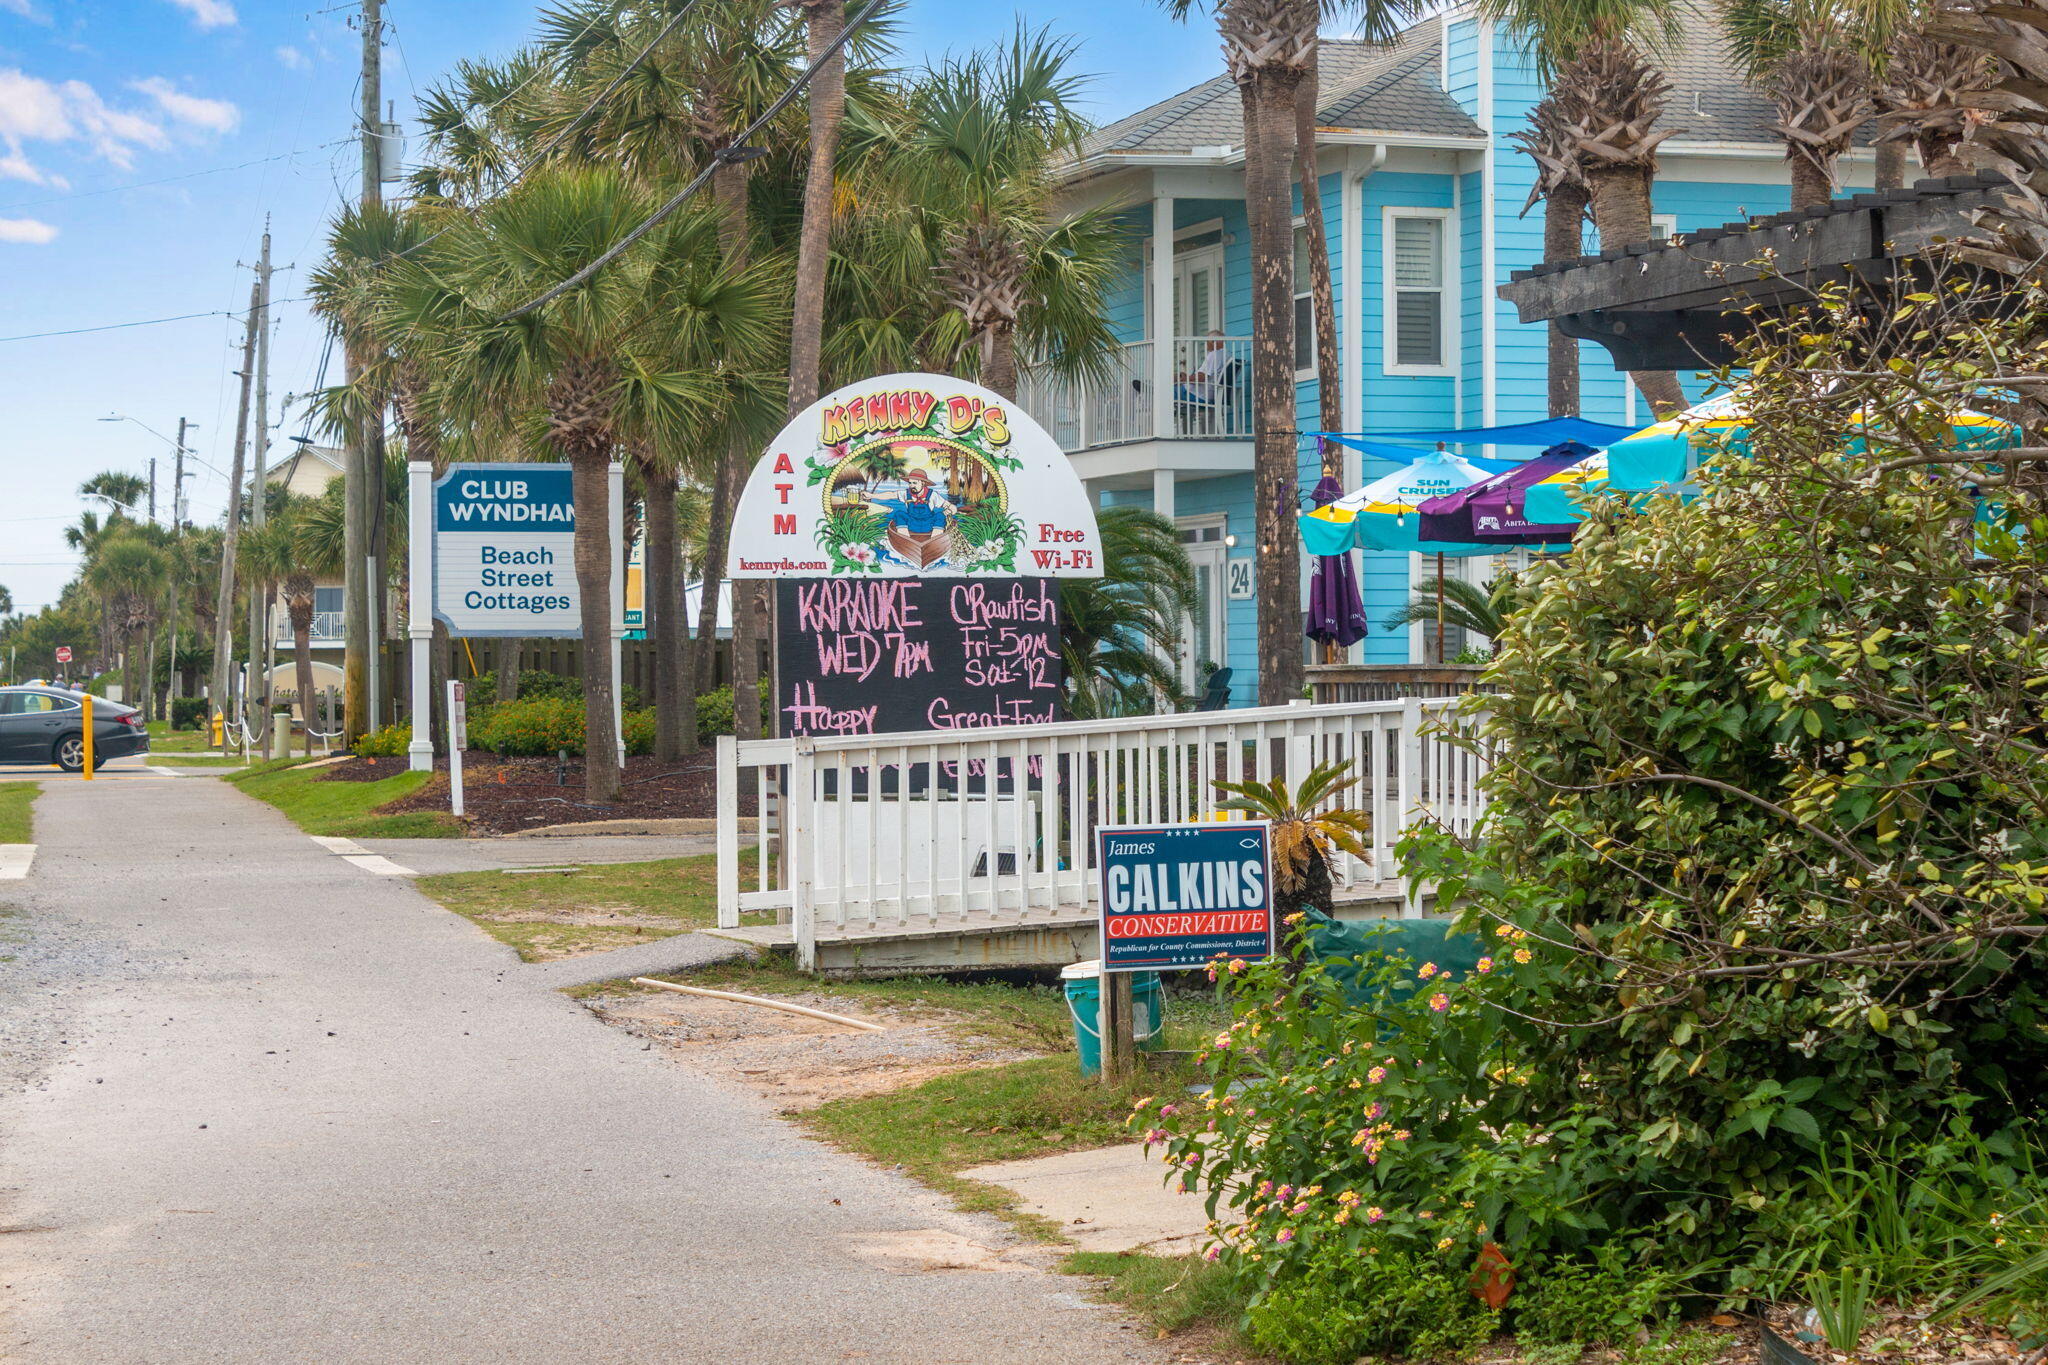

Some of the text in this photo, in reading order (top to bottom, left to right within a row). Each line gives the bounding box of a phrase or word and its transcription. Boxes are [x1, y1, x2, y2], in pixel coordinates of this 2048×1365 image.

[822, 390, 1011, 446] KENNY D'S
[461, 480, 529, 500] CLUB
[773, 452, 797, 535] ATM
[1416, 479, 1450, 487] SUN
[1038, 524, 1085, 543] Free
[481, 546, 554, 565] Beach
[739, 557, 828, 574] kennyds.com
[1031, 550, 1094, 569] Wi-Fi
[481, 568, 554, 587] Street
[1231, 563, 1249, 593] 24
[464, 591, 570, 614] Cottages
[798, 579, 923, 632] KARAOKE
[816, 630, 881, 683] WED
[782, 680, 878, 736] Happy
[1108, 840, 1155, 857] James
[1107, 860, 1264, 913] CALKINS
[1108, 912, 1264, 937] CONSERVATIVE
[1109, 938, 1266, 953] Republican for County Commissioner, District 4
